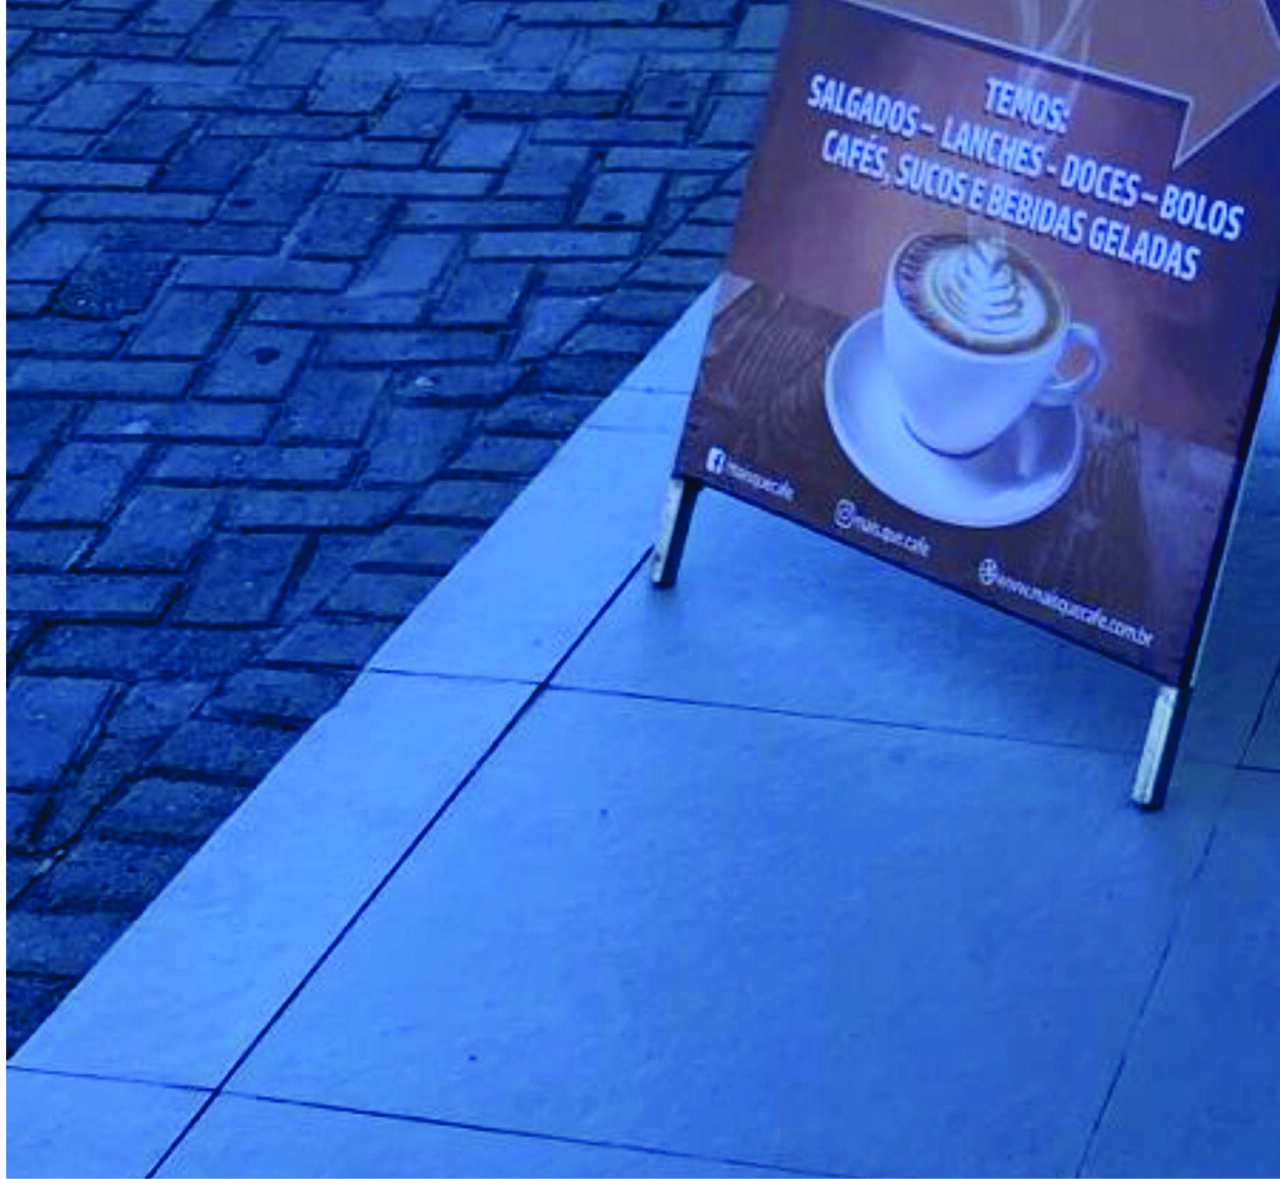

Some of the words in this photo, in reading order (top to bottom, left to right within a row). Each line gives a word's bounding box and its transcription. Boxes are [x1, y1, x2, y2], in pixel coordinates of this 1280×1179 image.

[807, 74, 920, 139] SALGADOS
[941, 115, 1043, 177] LANCHES
[1060, 154, 1141, 207] DOCES
[1160, 184, 1245, 241] BOLOS
[984, 76, 1071, 134] TEMOS:
[821, 128, 890, 186] CAFÉS,
[894, 153, 968, 206] SUCOS
[969, 178, 985, 211] E
[987, 182, 1088, 244] BEBIDAS
[1089, 217, 1201, 281] GELADAS
